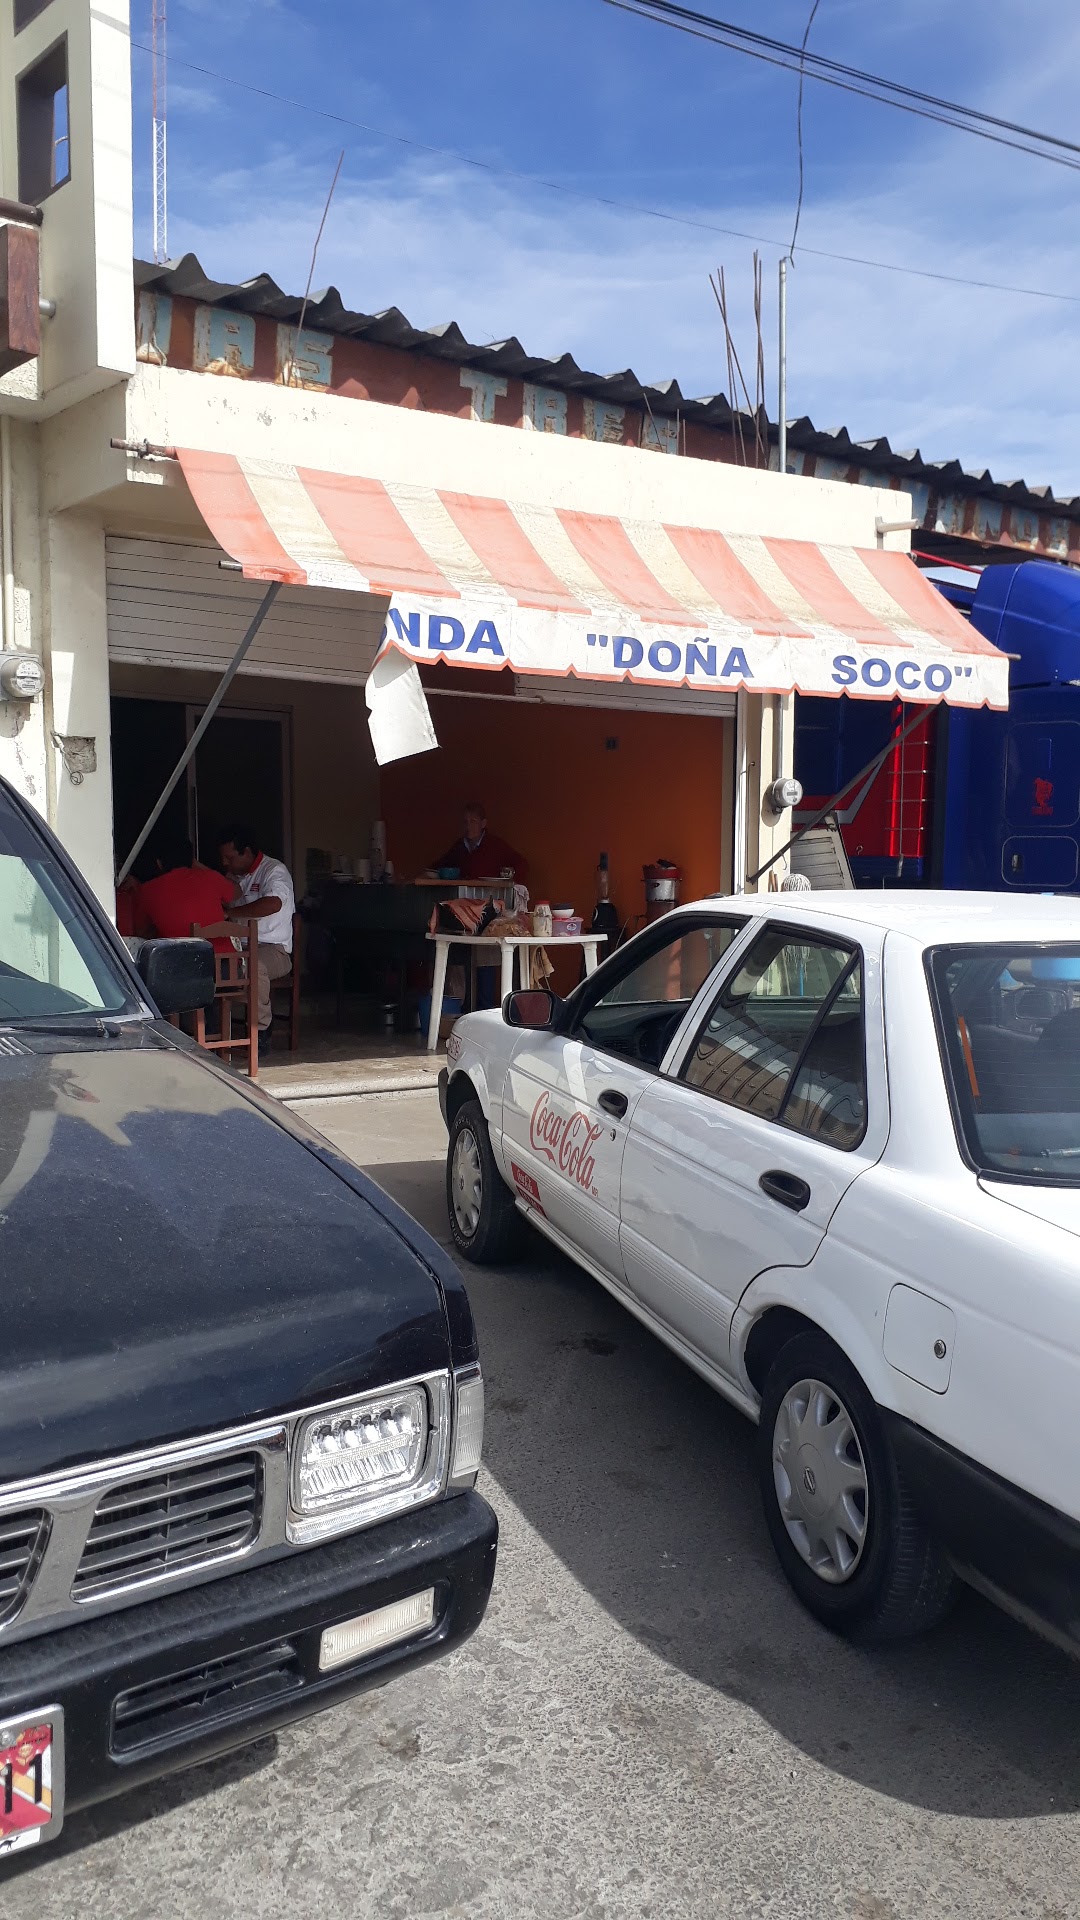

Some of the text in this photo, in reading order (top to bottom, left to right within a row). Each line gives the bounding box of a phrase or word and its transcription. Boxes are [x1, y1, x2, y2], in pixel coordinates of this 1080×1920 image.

[378, 608, 973, 693] NDA "DOÑA SOCO"
